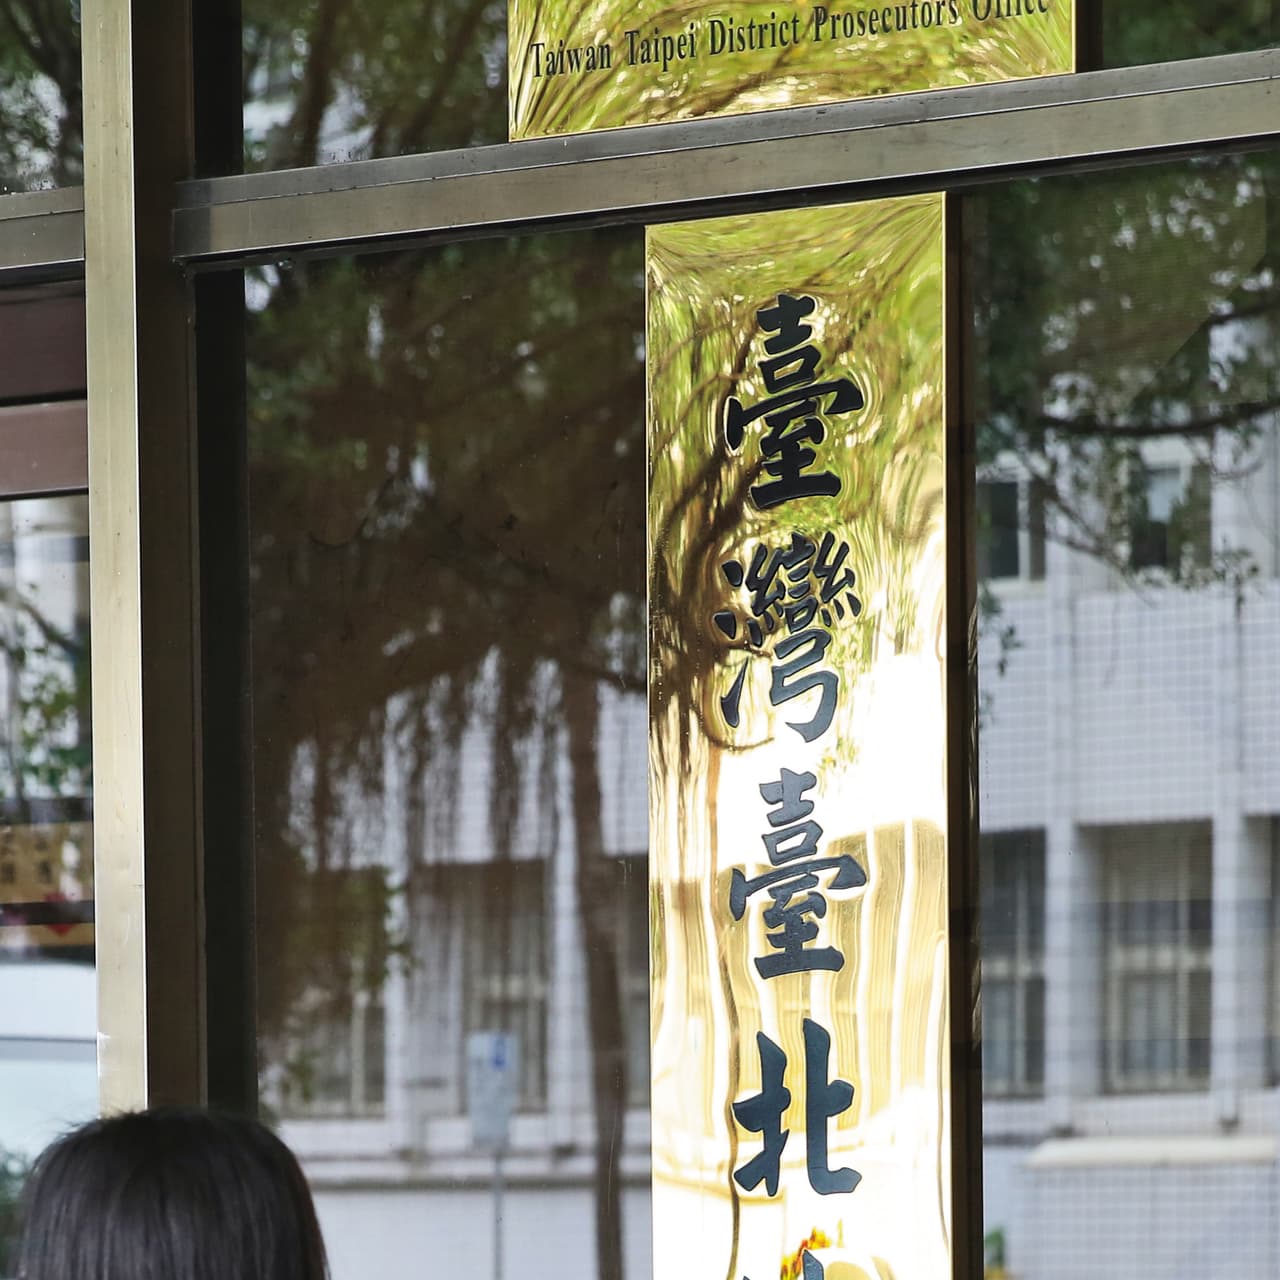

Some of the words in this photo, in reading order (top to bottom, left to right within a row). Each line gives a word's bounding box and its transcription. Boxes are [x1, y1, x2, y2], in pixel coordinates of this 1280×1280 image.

[530, 39, 613, 78] Taiwan
[624, 22, 698, 73] Taipei
[708, 11, 800, 56] District
[812, 0, 959, 42] Prosecutors
